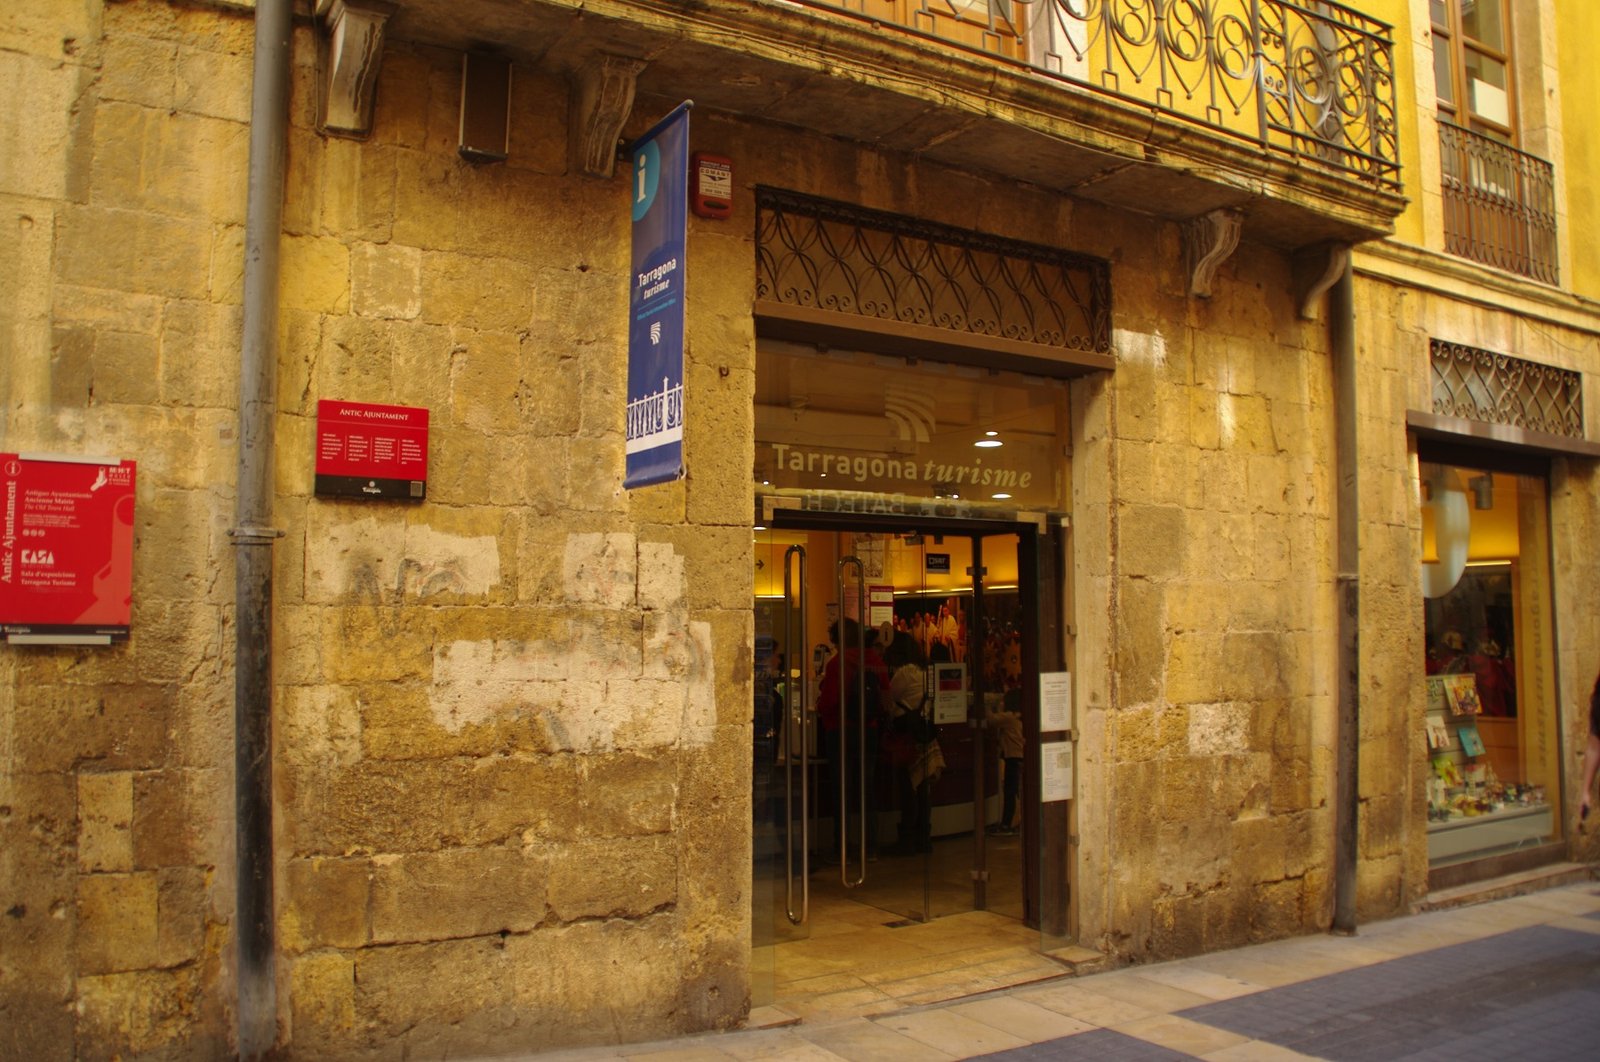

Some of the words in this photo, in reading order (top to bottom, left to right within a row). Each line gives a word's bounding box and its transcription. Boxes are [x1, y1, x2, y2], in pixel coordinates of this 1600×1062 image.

[638, 258, 677, 288] Tarragona
[643, 279, 670, 300] turisme
[339, 408, 362, 417] ANTIC
[363, 410, 409, 421] AJUNTAMENT
[772, 444, 918, 482] Tarragona
[923, 458, 1032, 489] turisme
[2, 480, 17, 549] Ajuntament
[1, 552, 13, 584] Antic
